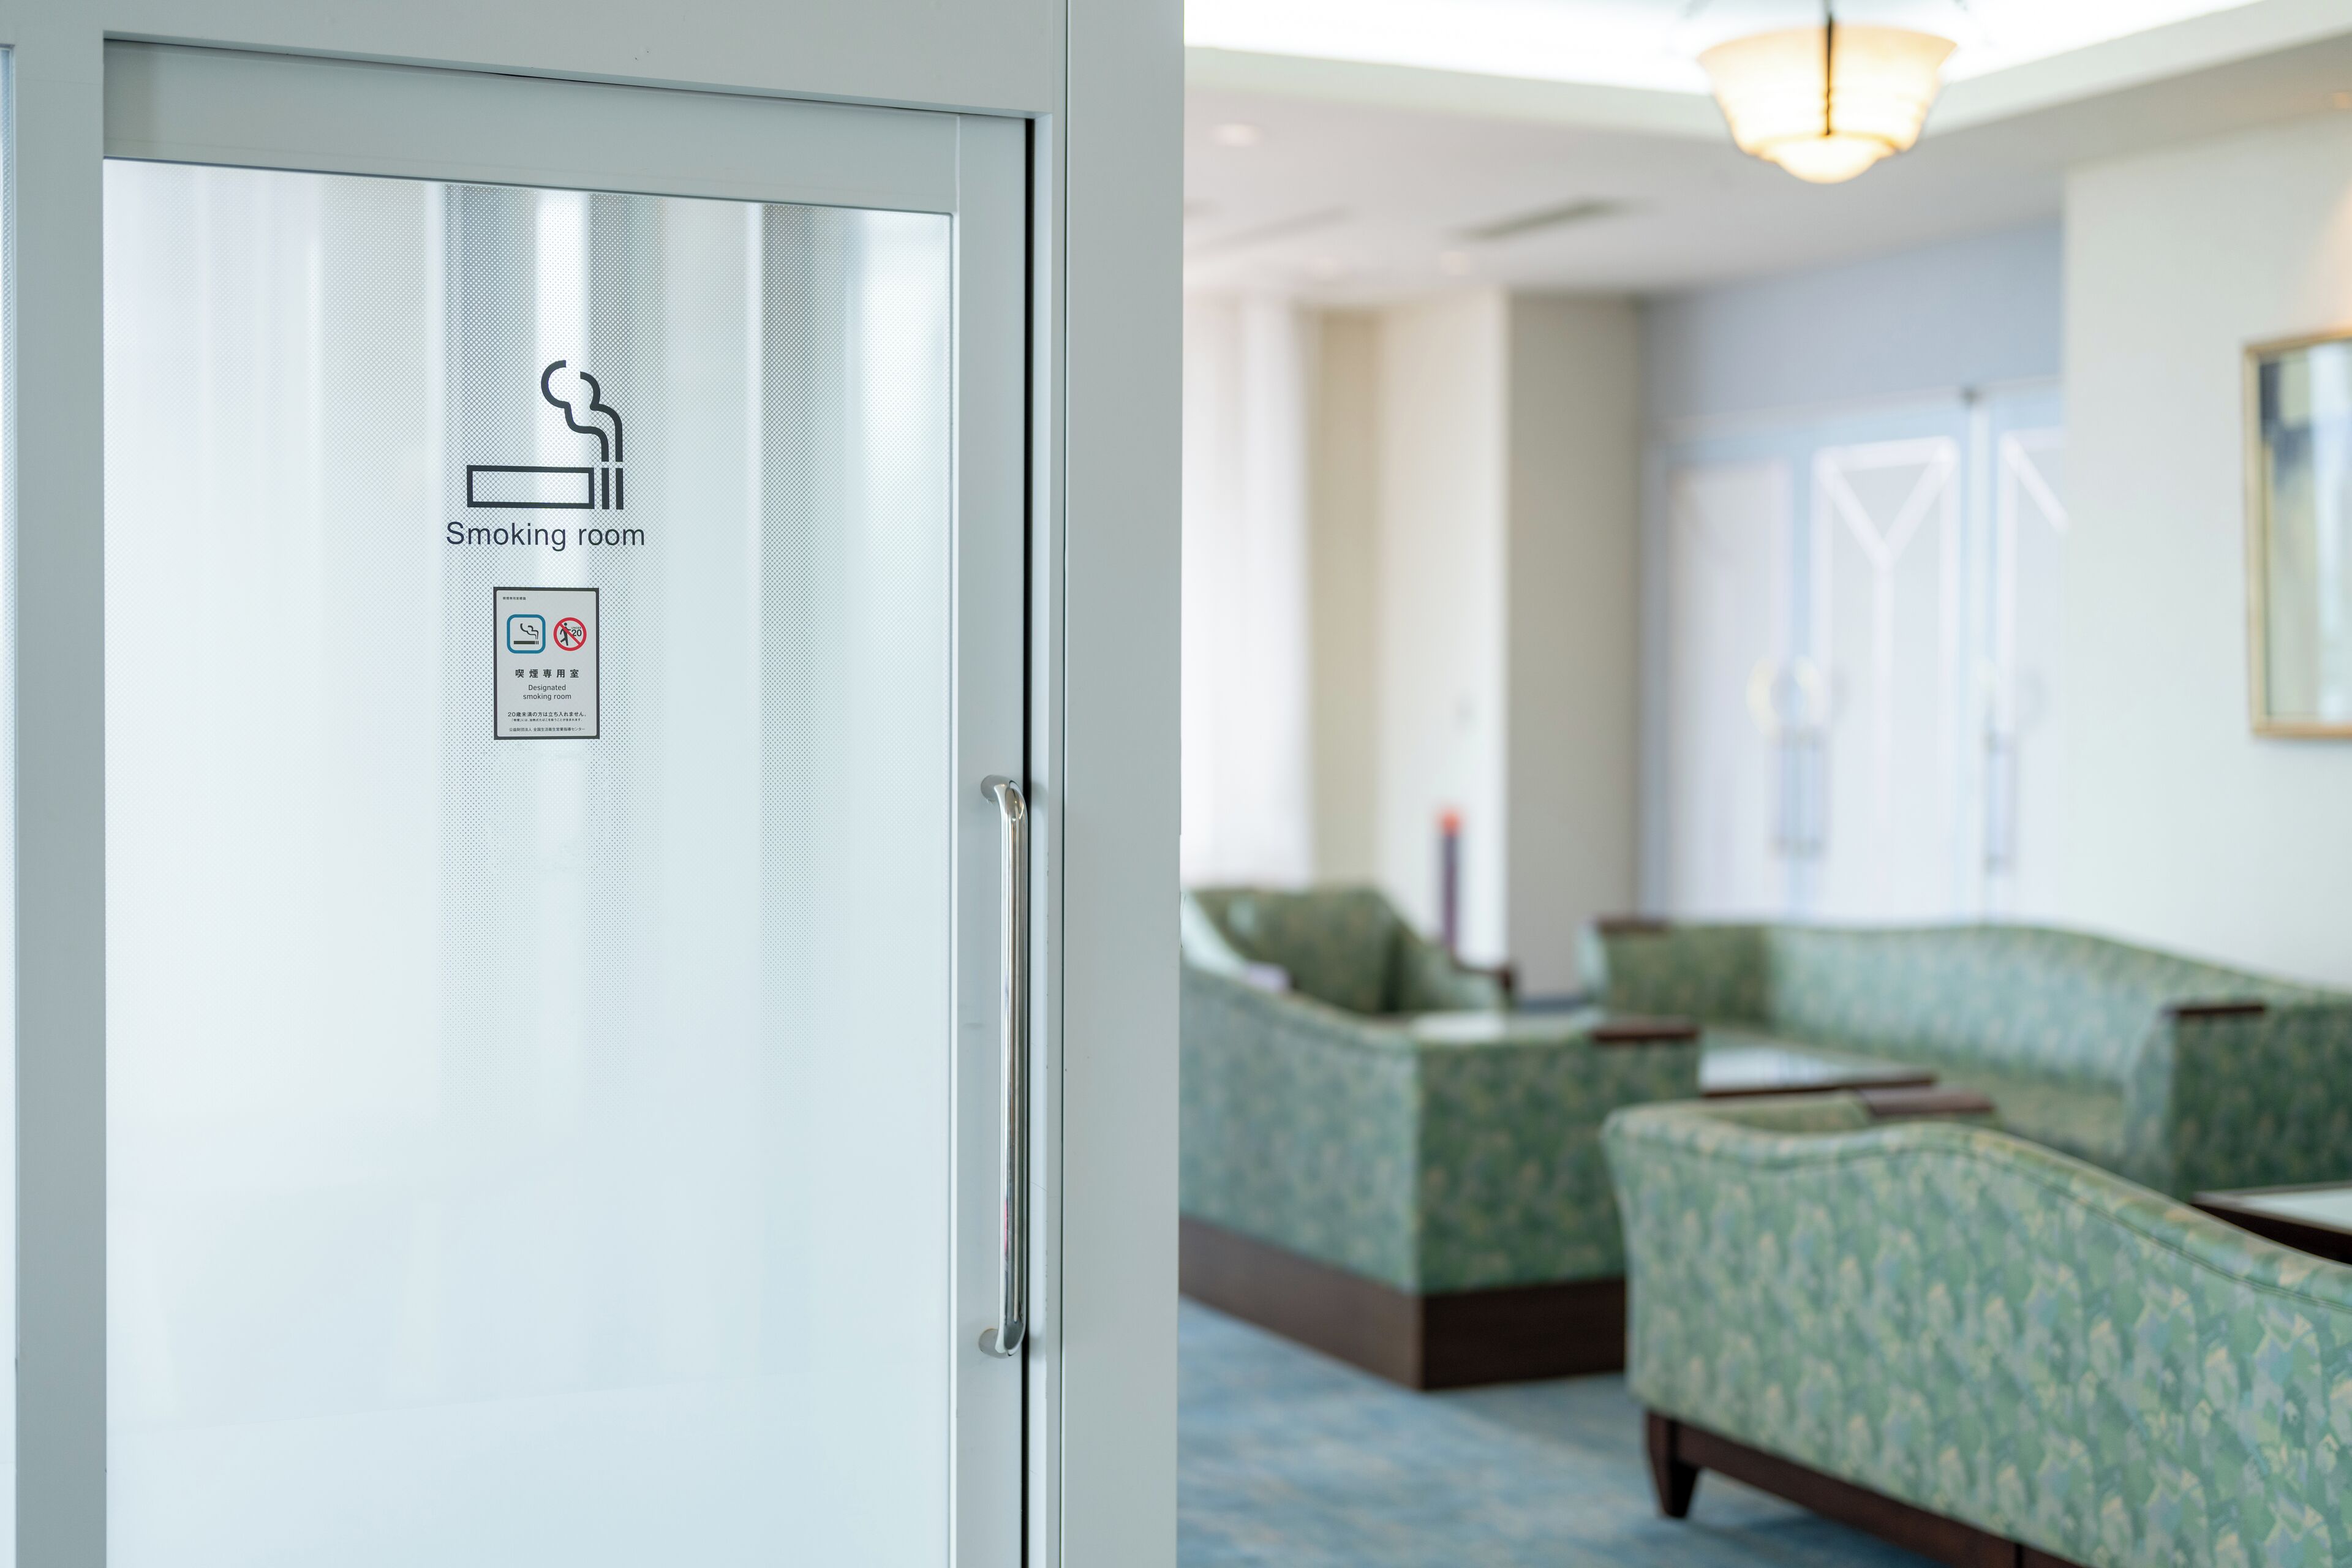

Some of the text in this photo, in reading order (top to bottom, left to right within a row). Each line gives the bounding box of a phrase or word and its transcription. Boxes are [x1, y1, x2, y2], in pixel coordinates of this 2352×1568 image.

[447, 521, 645, 552] Smoking room
[515, 669, 579, 678] 喫煙専用室
